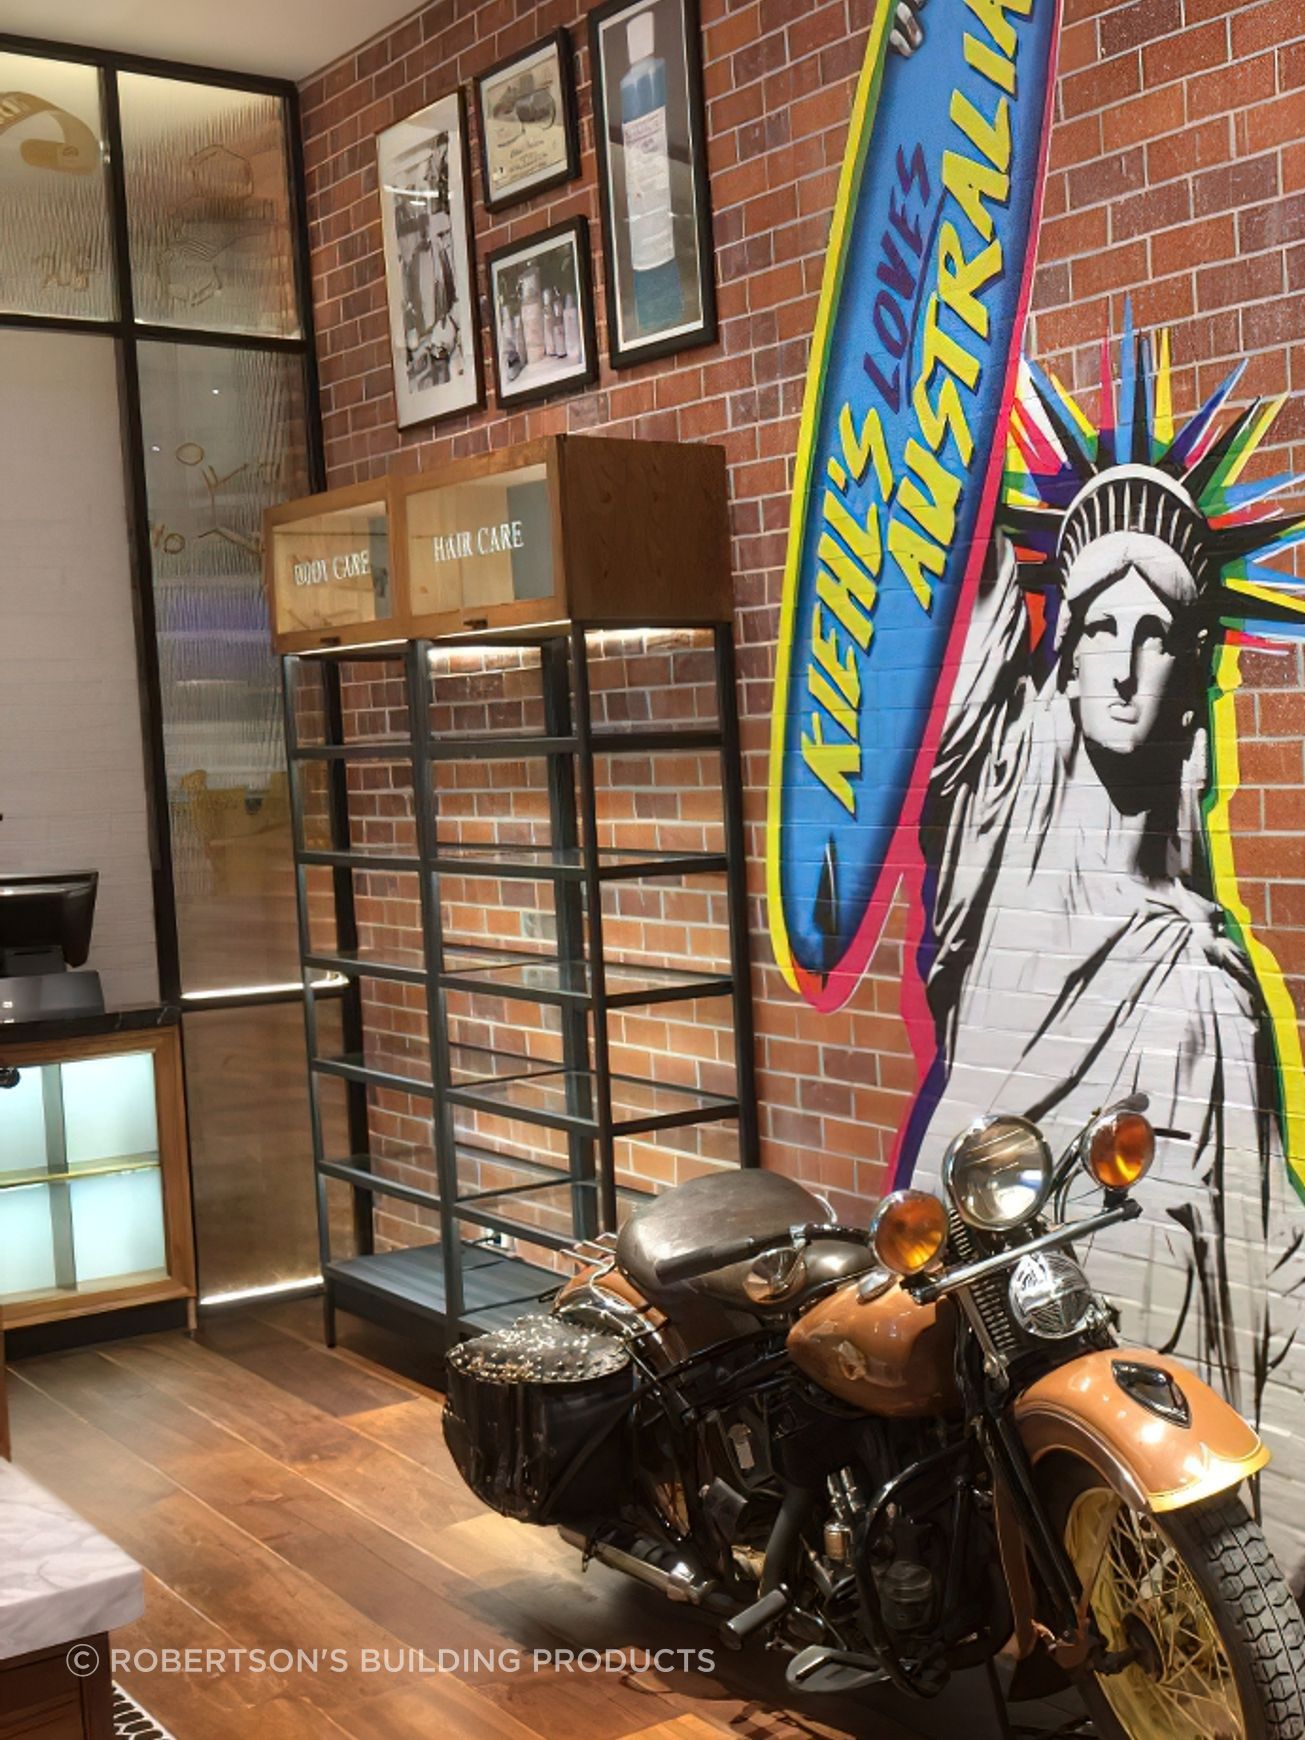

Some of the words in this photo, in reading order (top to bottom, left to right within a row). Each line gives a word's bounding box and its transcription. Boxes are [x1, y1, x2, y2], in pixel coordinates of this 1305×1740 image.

[887, 0, 1034, 612] AUSTRALIA
[332, 549, 371, 580] CARE
[433, 530, 473, 562] HAIR
[477, 520, 525, 555] CARE
[801, 402, 894, 816] KIEHL'S
[863, 143, 931, 415] LOVES
